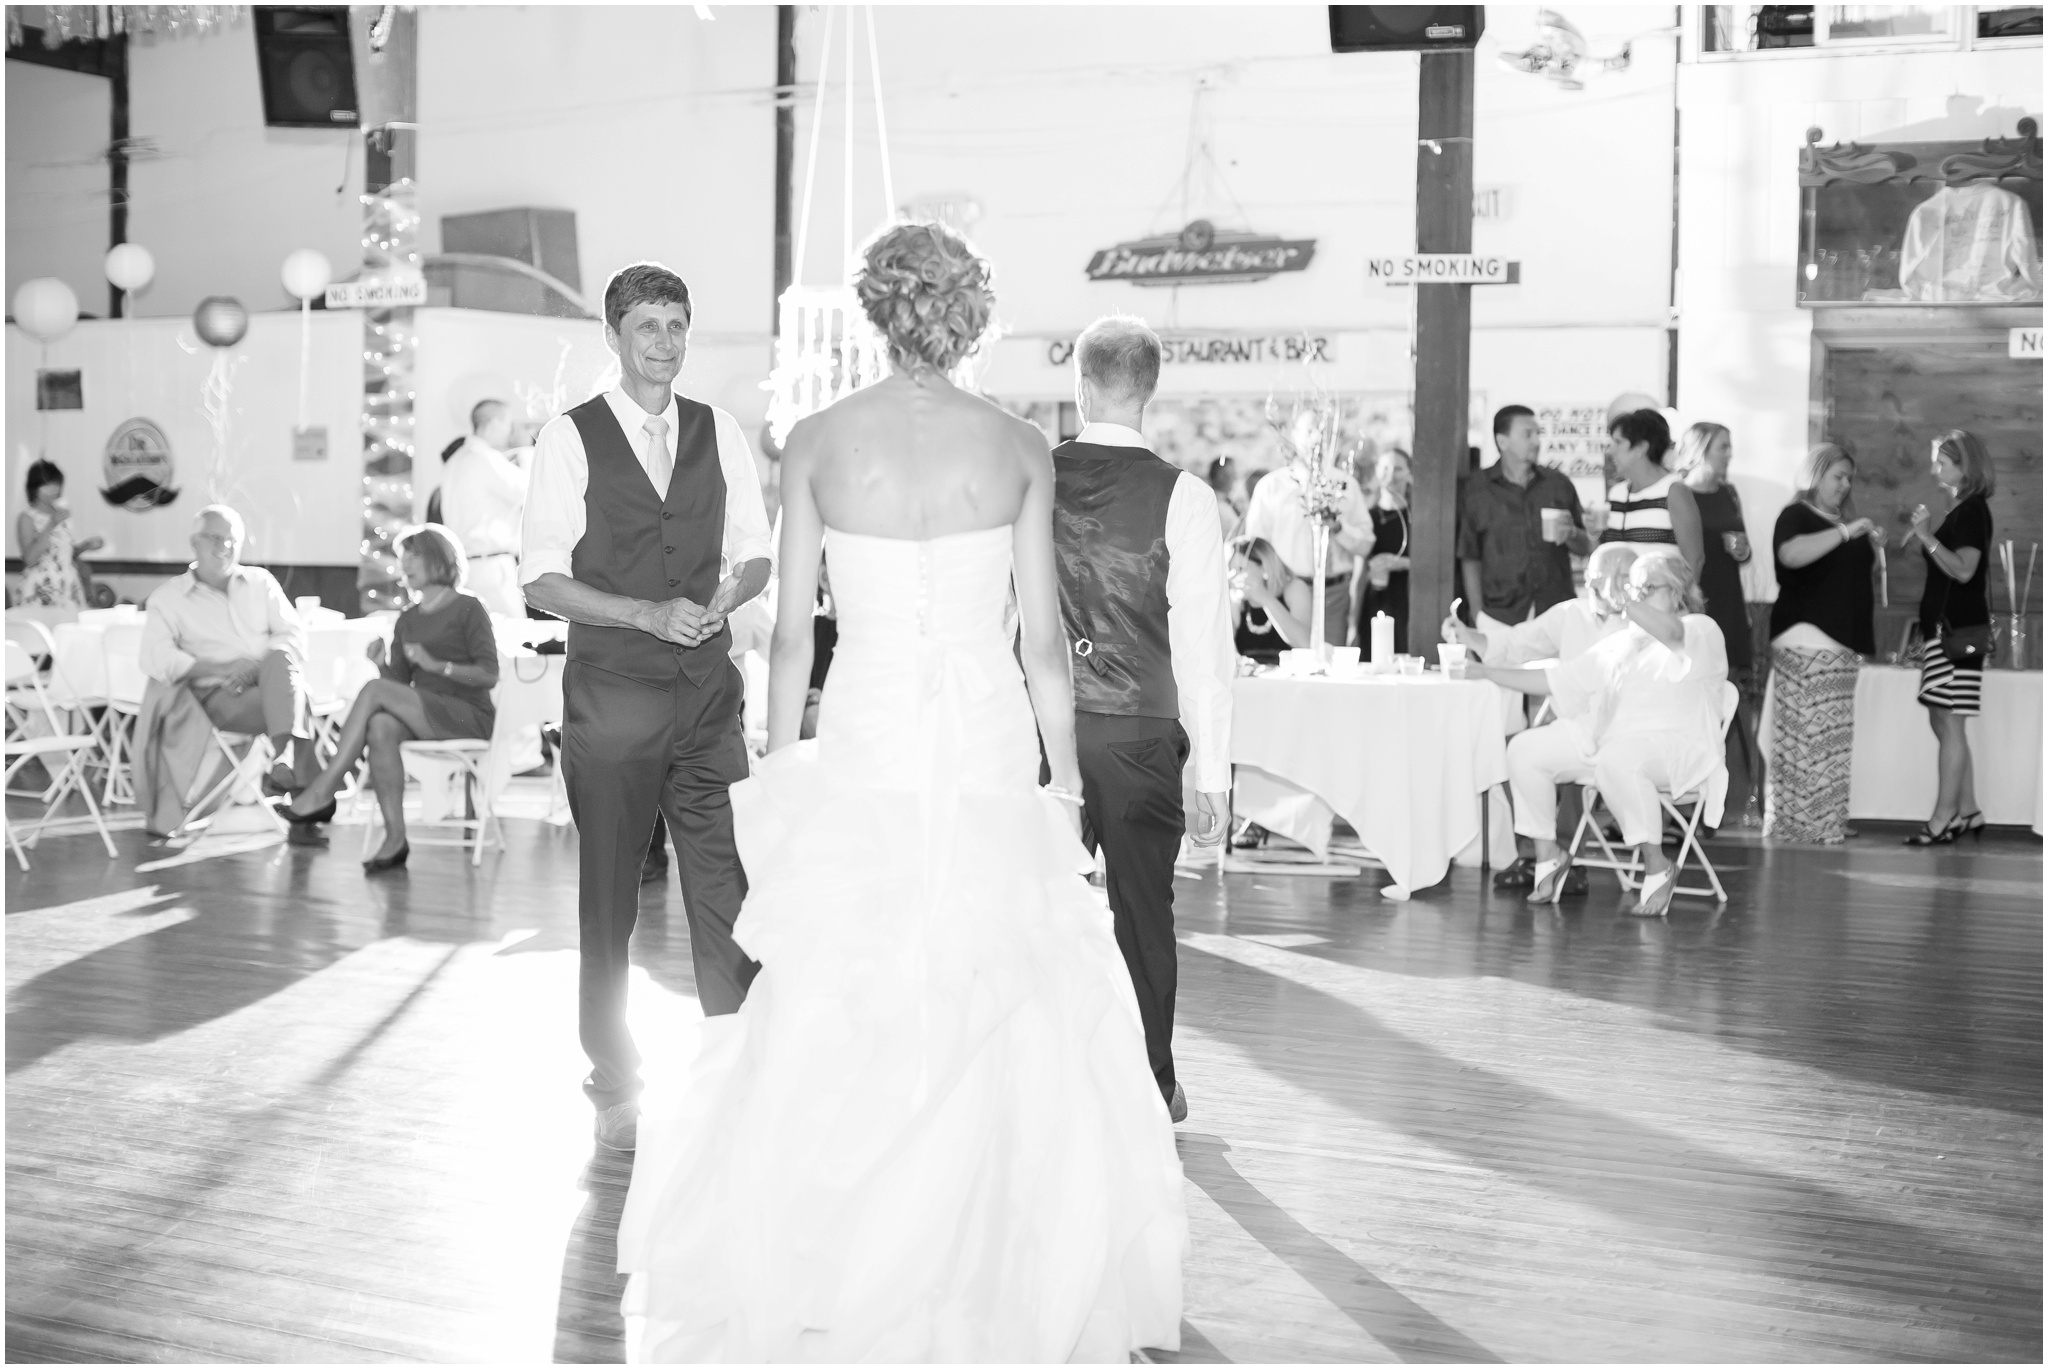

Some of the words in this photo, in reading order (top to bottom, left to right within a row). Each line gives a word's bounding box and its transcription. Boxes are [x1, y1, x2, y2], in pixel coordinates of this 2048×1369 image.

[1369, 259, 1394, 277] NO
[1404, 258, 1500, 276] SMOKING
[2021, 332, 2043, 352] N
[1548, 441, 1579, 453] ANY
